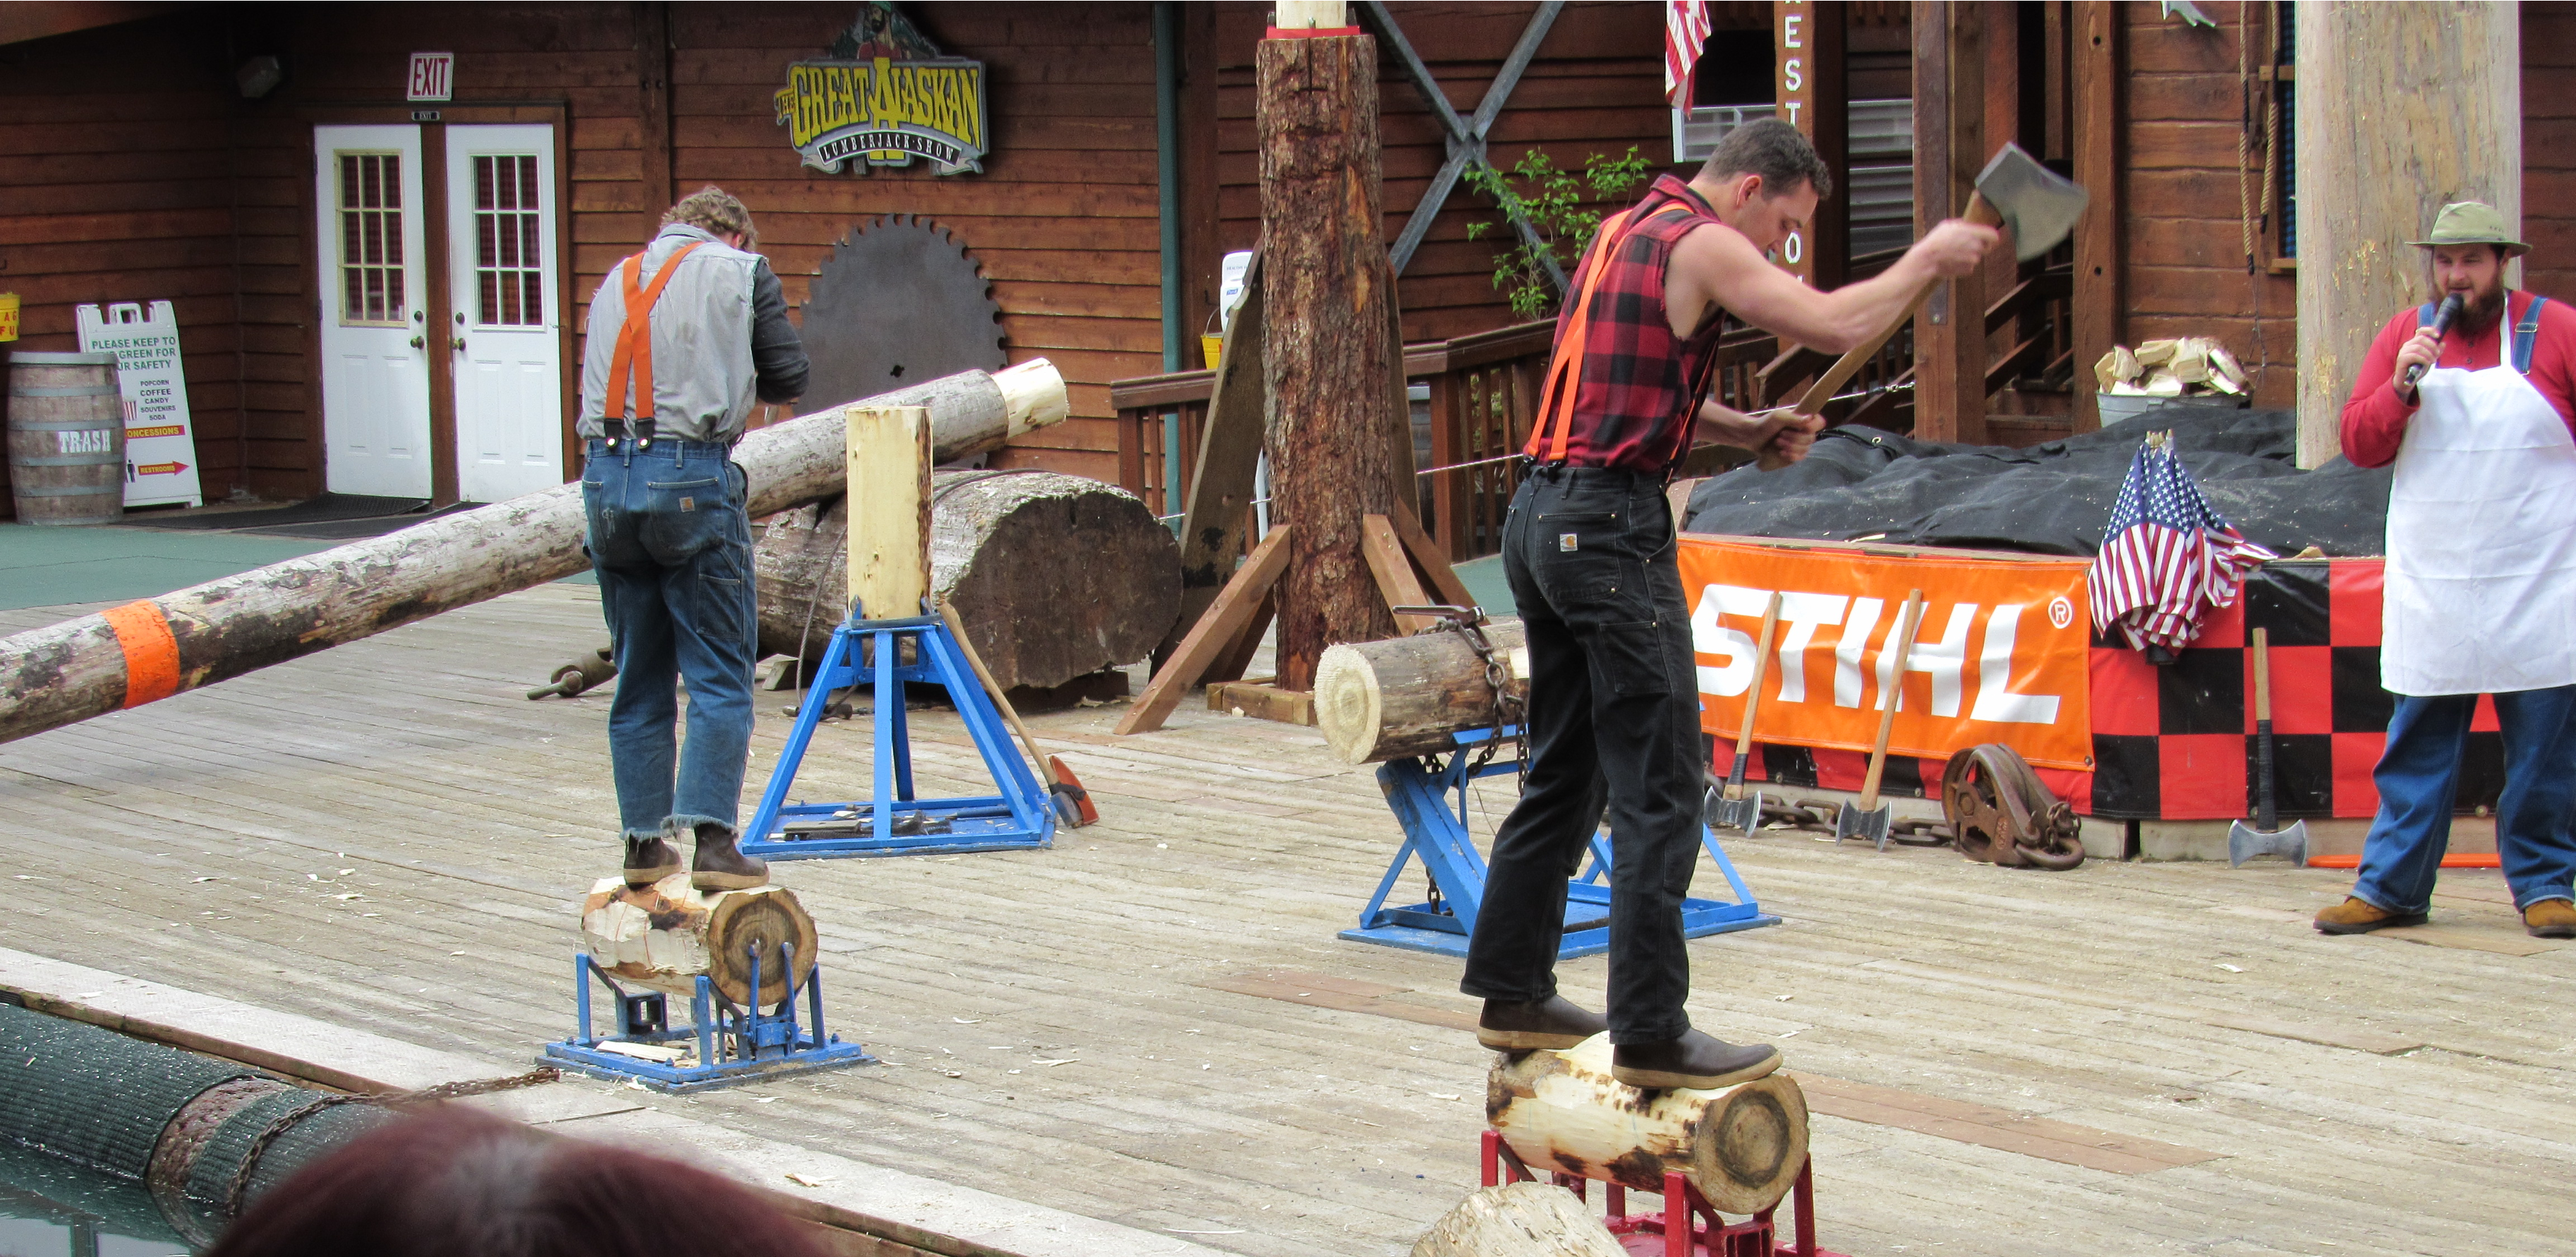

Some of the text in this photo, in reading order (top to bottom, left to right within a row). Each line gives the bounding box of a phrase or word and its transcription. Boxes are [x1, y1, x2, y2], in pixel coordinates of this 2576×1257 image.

[412, 58, 450, 96] EXIT
[775, 57, 982, 160] THE GREAT ALASKAN
[823, 133, 955, 162] LUMBERJACK SHOW
[92, 337, 176, 349] PLEASE KEEP TO
[118, 347, 176, 359] GREEN FOR
[133, 359, 172, 371] SAFETY
[140, 388, 172, 397] COFFEE
[140, 405, 176, 414] SOUVENIRS
[127, 426, 180, 438] ONCESSIONS
[58, 430, 111, 452] TRASH
[140, 465, 176, 474] RESTROOMS
[1691, 583, 2061, 726] STIHL
